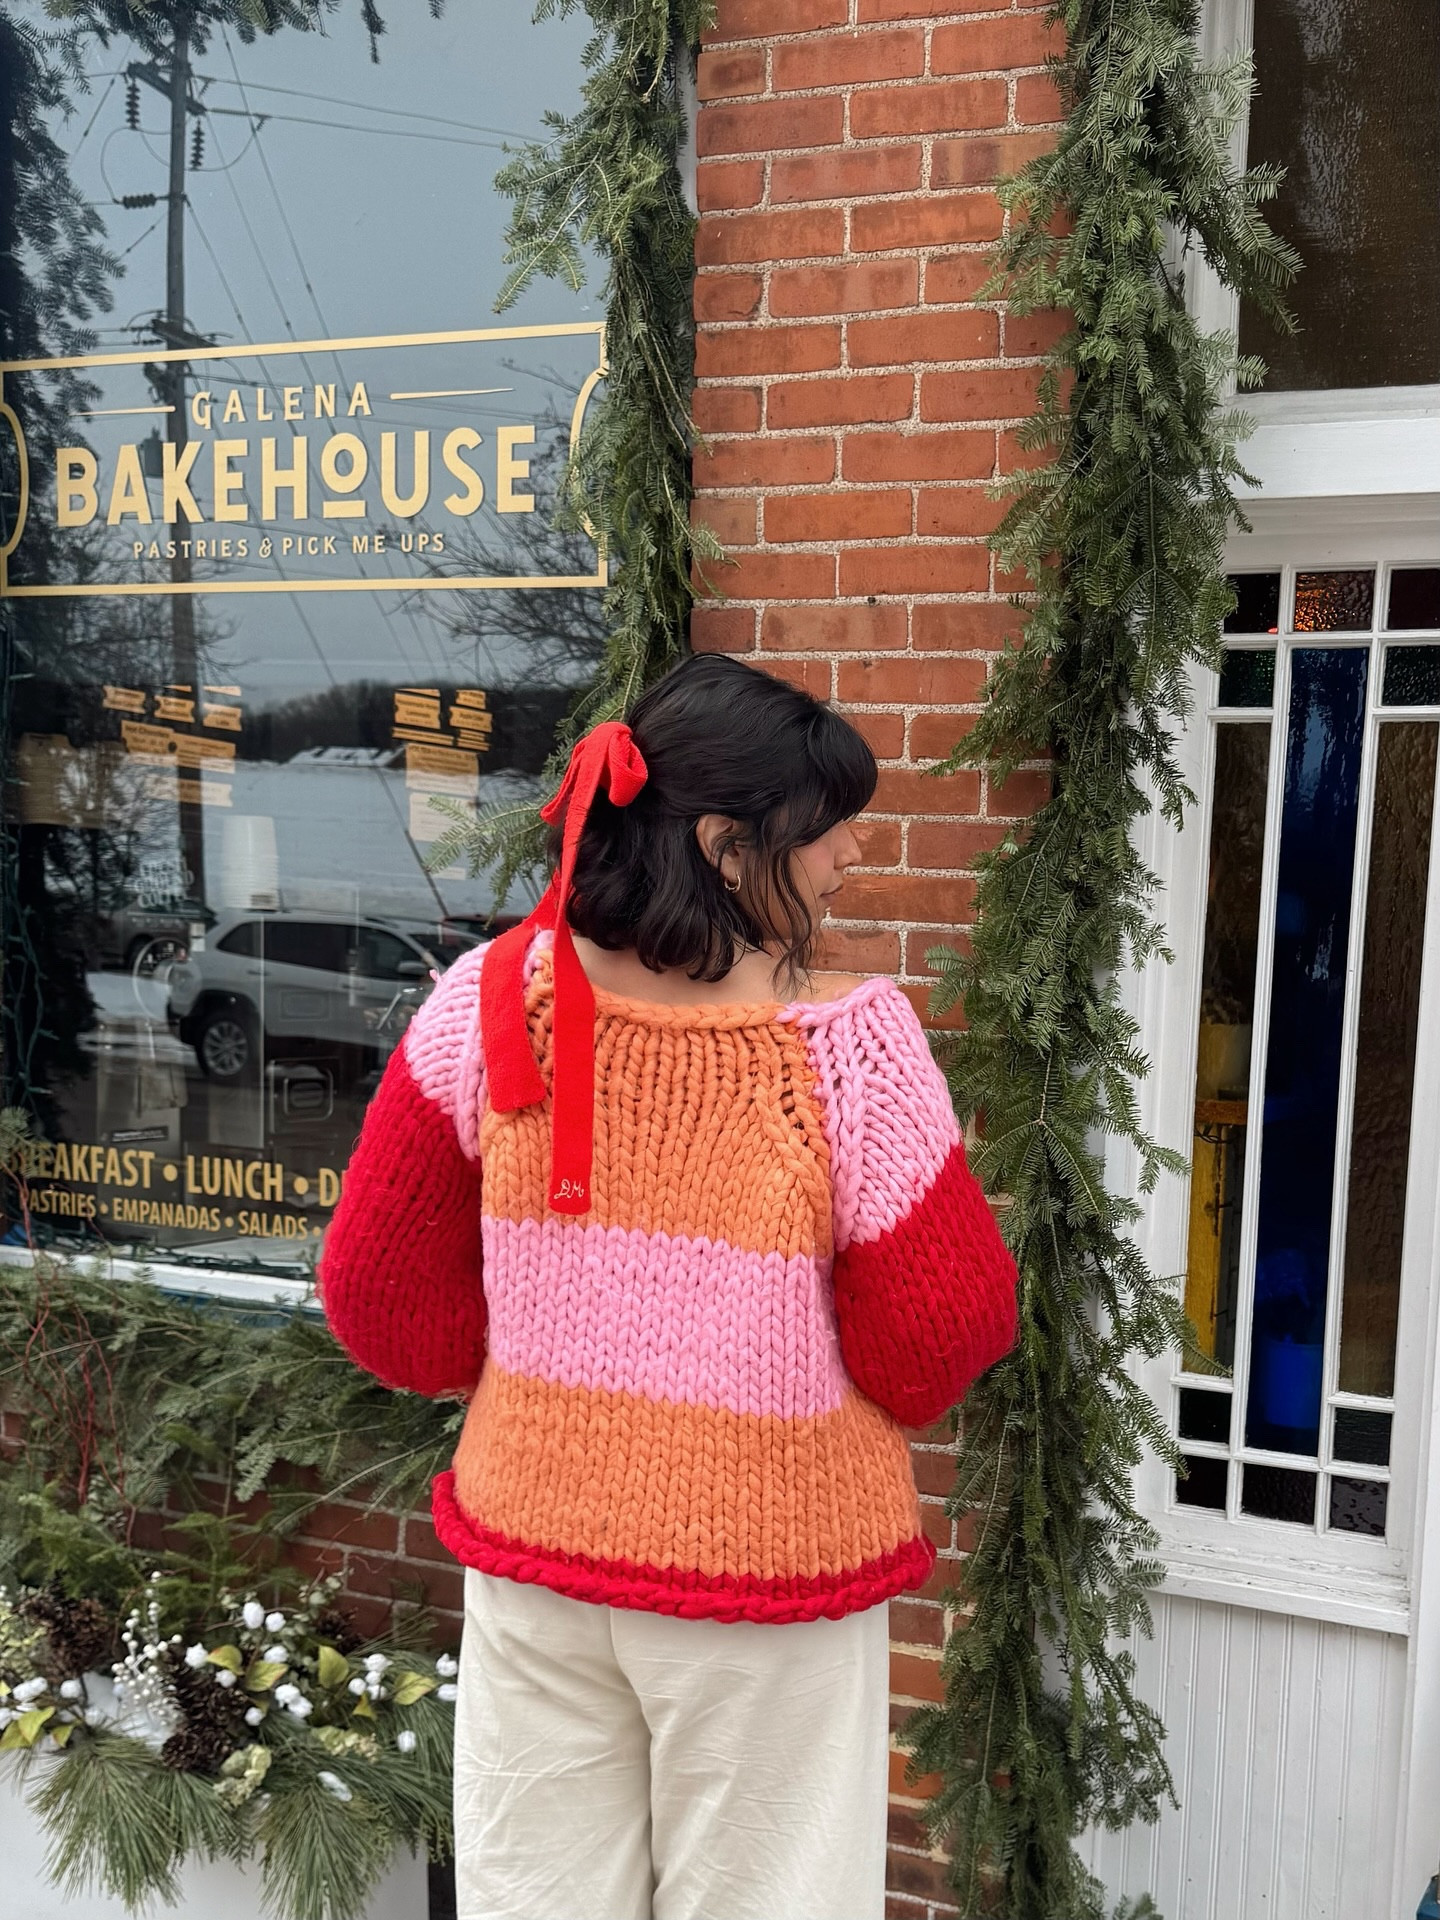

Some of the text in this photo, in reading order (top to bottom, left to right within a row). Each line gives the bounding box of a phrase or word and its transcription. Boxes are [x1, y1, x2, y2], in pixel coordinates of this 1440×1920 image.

[192, 382, 373, 429] GALENA
[56, 425, 536, 527] BAKEHOUSE
[133, 532, 445, 559] PASTRIES & PICK ME UPS
[9, 1141, 346, 1207] EAKFAST LUNCH D
[21, 1188, 308, 1240] ASTRIES EMPANADAS SALADS
